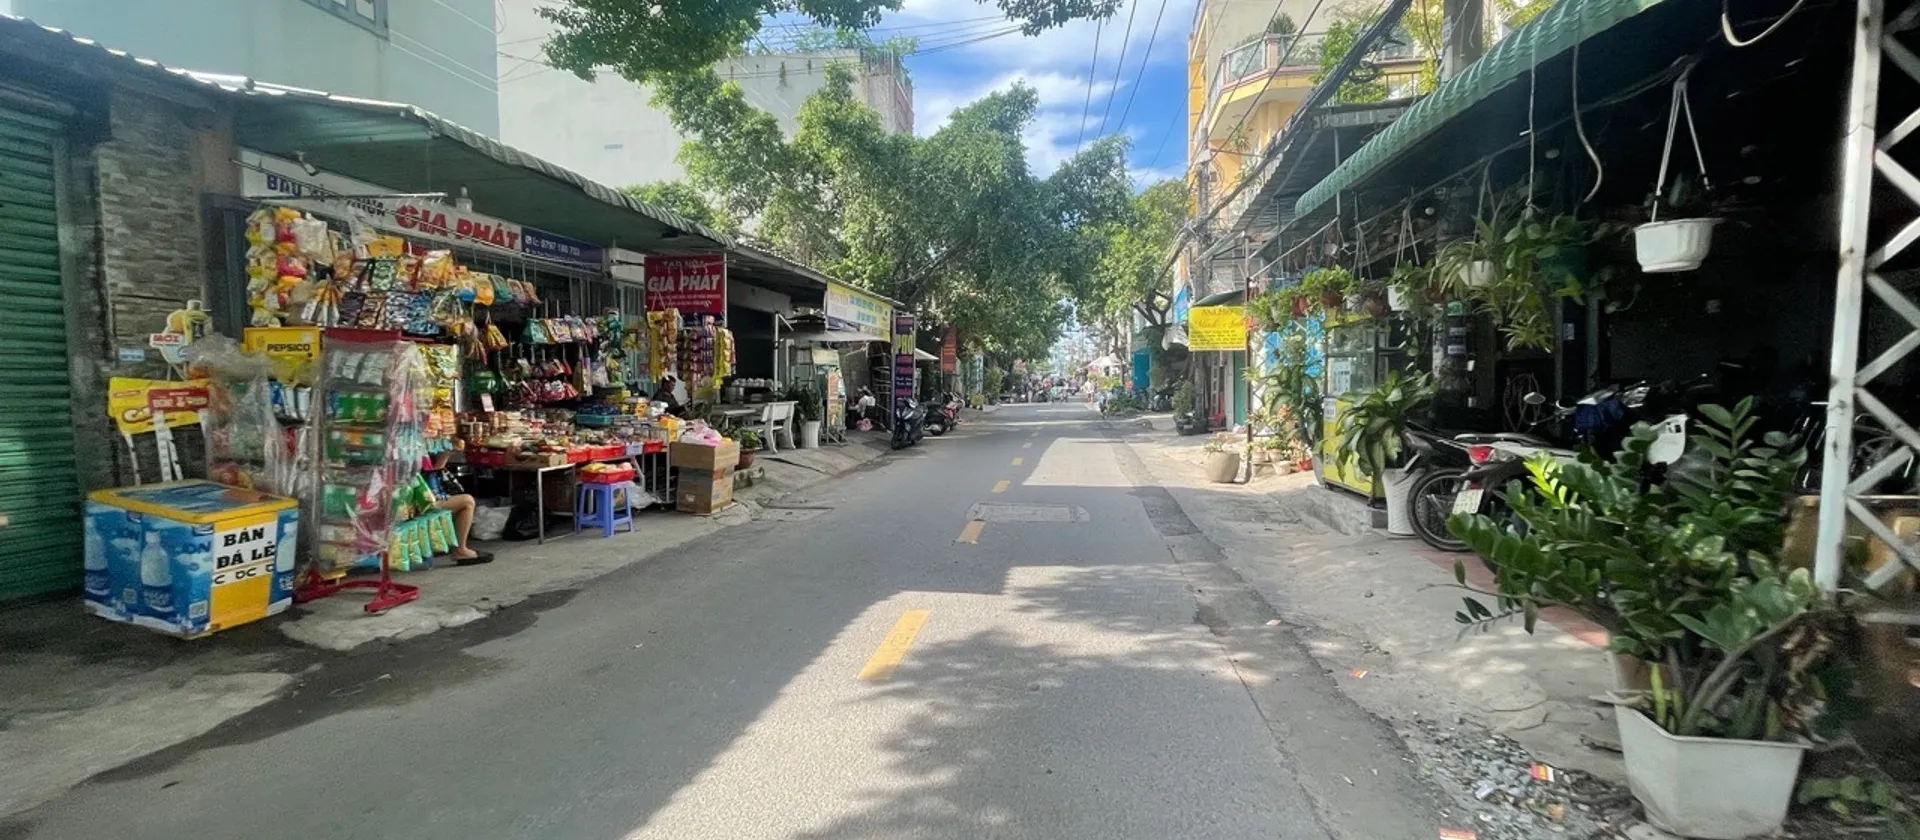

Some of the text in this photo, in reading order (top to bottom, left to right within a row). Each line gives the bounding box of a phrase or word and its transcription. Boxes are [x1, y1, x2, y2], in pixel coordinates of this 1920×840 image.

[395, 204, 520, 250] GIA PHÁT
[648, 276, 675, 292] GIA
[266, 343, 310, 353] PEPSICO
[223, 527, 265, 547] BÁN
[216, 540, 276, 570] ĐÁ LẺ
